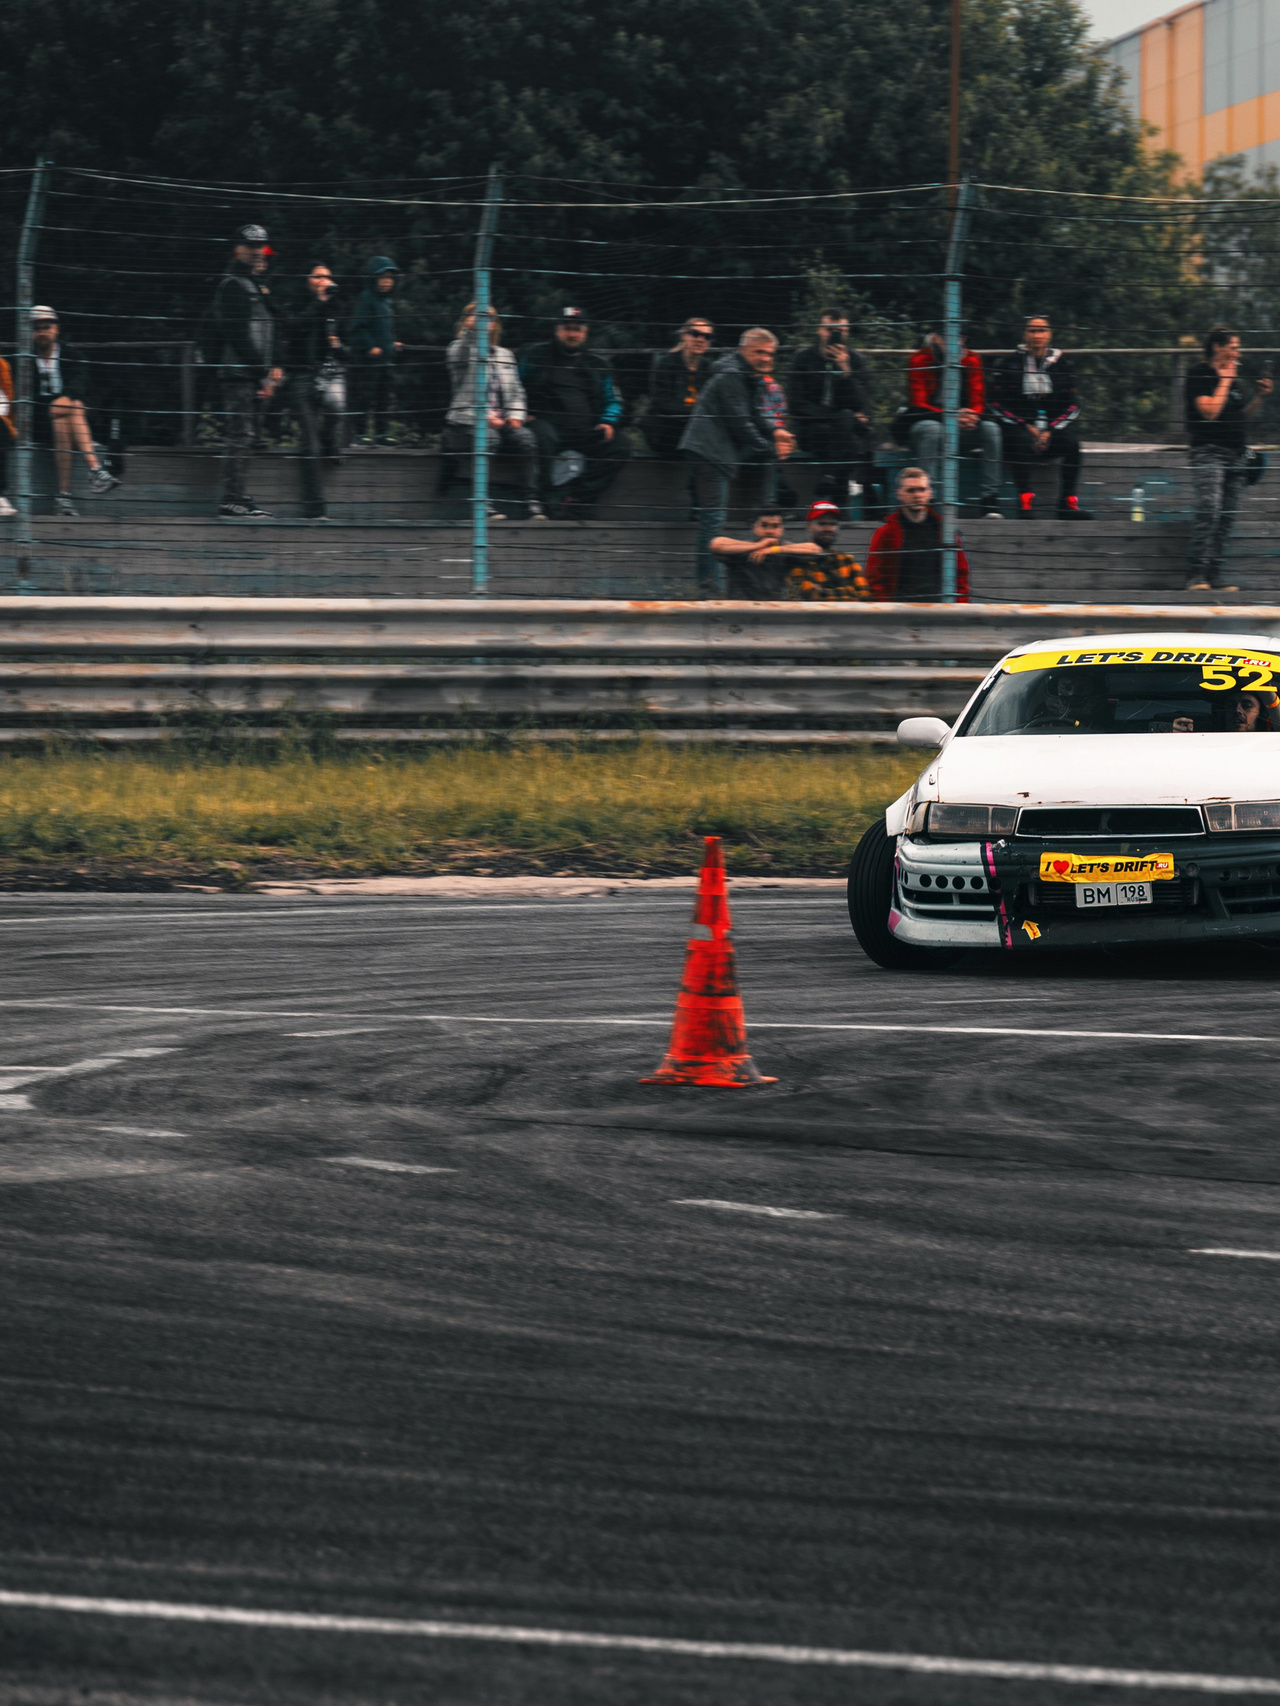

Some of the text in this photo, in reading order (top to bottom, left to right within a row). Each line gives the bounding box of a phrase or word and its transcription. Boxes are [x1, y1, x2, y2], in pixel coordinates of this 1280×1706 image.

[1056, 651, 1144, 666] LET'S
[1199, 665, 1278, 692] 52
[1044, 861, 1052, 872] I
[1069, 862, 1110, 874] LET'S
[1083, 885, 1146, 905] BM 198
